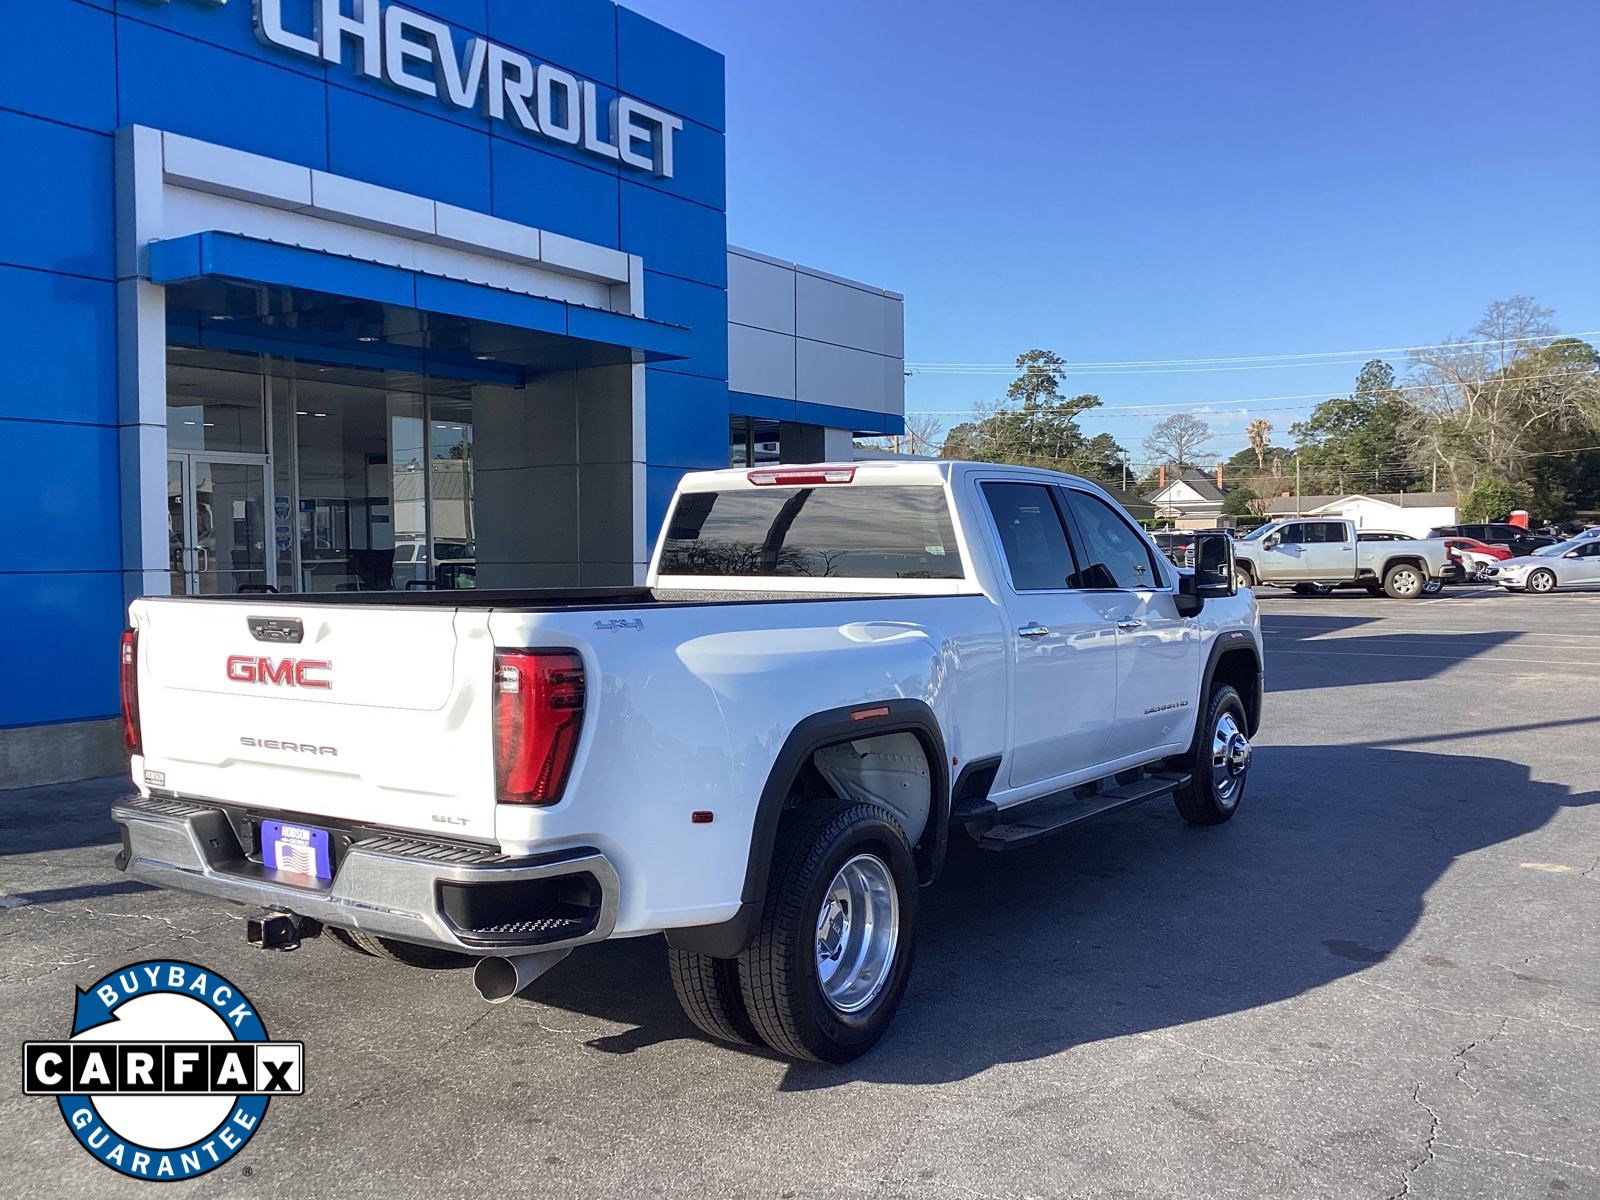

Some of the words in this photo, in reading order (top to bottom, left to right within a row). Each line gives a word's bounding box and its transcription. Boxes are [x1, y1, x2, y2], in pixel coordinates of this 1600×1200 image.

[251, 0, 684, 179] CHEVROLET
[226, 654, 333, 690] GMC
[239, 736, 338, 757] SIERRA
[431, 814, 472, 826] SLT
